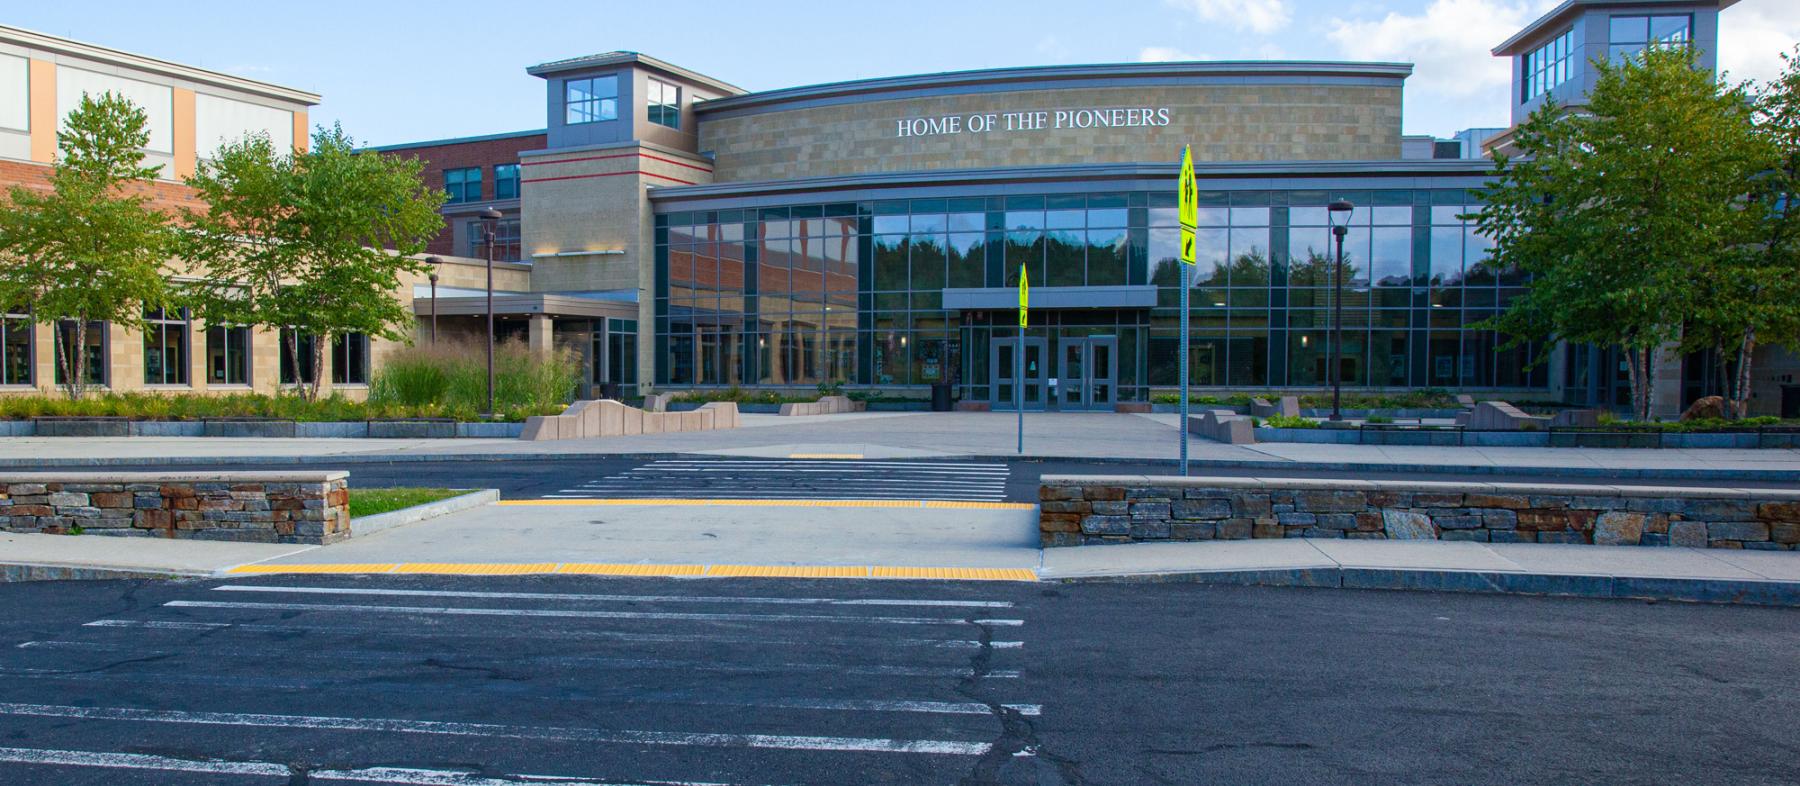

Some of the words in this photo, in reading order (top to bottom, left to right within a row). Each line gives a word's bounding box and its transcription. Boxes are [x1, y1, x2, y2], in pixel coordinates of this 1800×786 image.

[897, 117, 961, 137] HOME
[968, 114, 997, 132] OF
[1003, 112, 1048, 130] THE
[1055, 108, 1170, 129] PIONEERS
